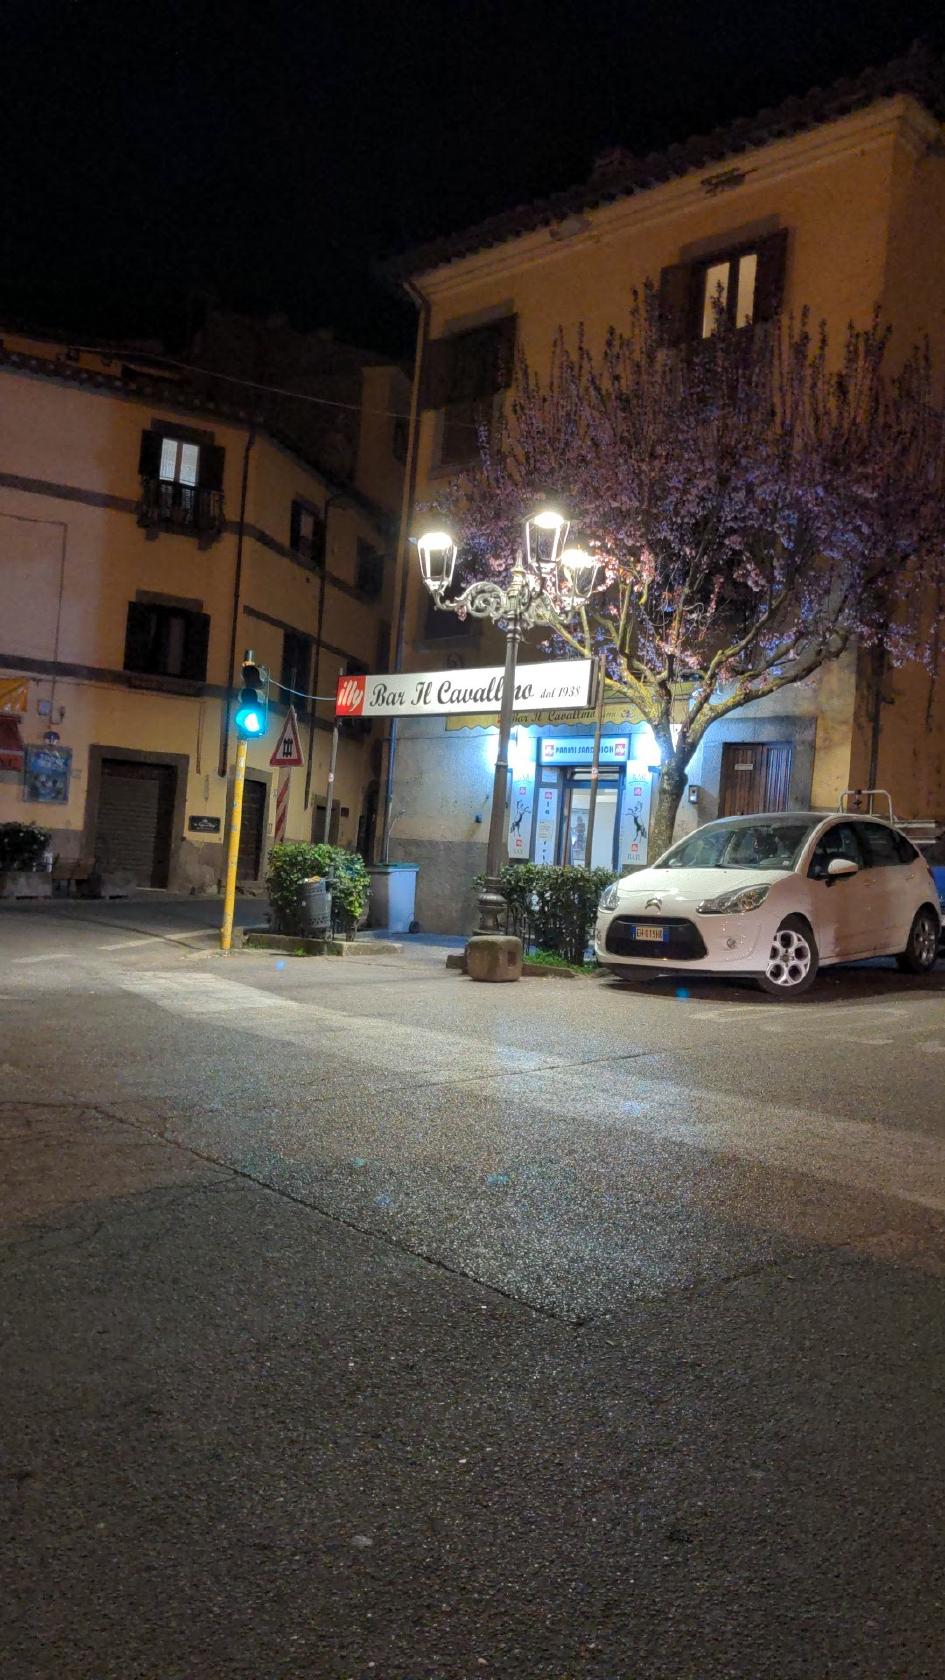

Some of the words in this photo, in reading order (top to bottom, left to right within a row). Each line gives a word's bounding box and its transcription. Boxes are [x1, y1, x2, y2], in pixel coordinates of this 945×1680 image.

[337, 678, 363, 712] illy
[369, 683, 406, 707] Bar
[411, 681, 433, 706] Il
[437, 675, 534, 705] Cavallno
[540, 687, 557, 699] dal
[558, 684, 581, 698] 1938
[510, 711, 528, 723] Bar
[548, 709, 595, 722] Cavallino
[578, 746, 614, 754] SANDICH
